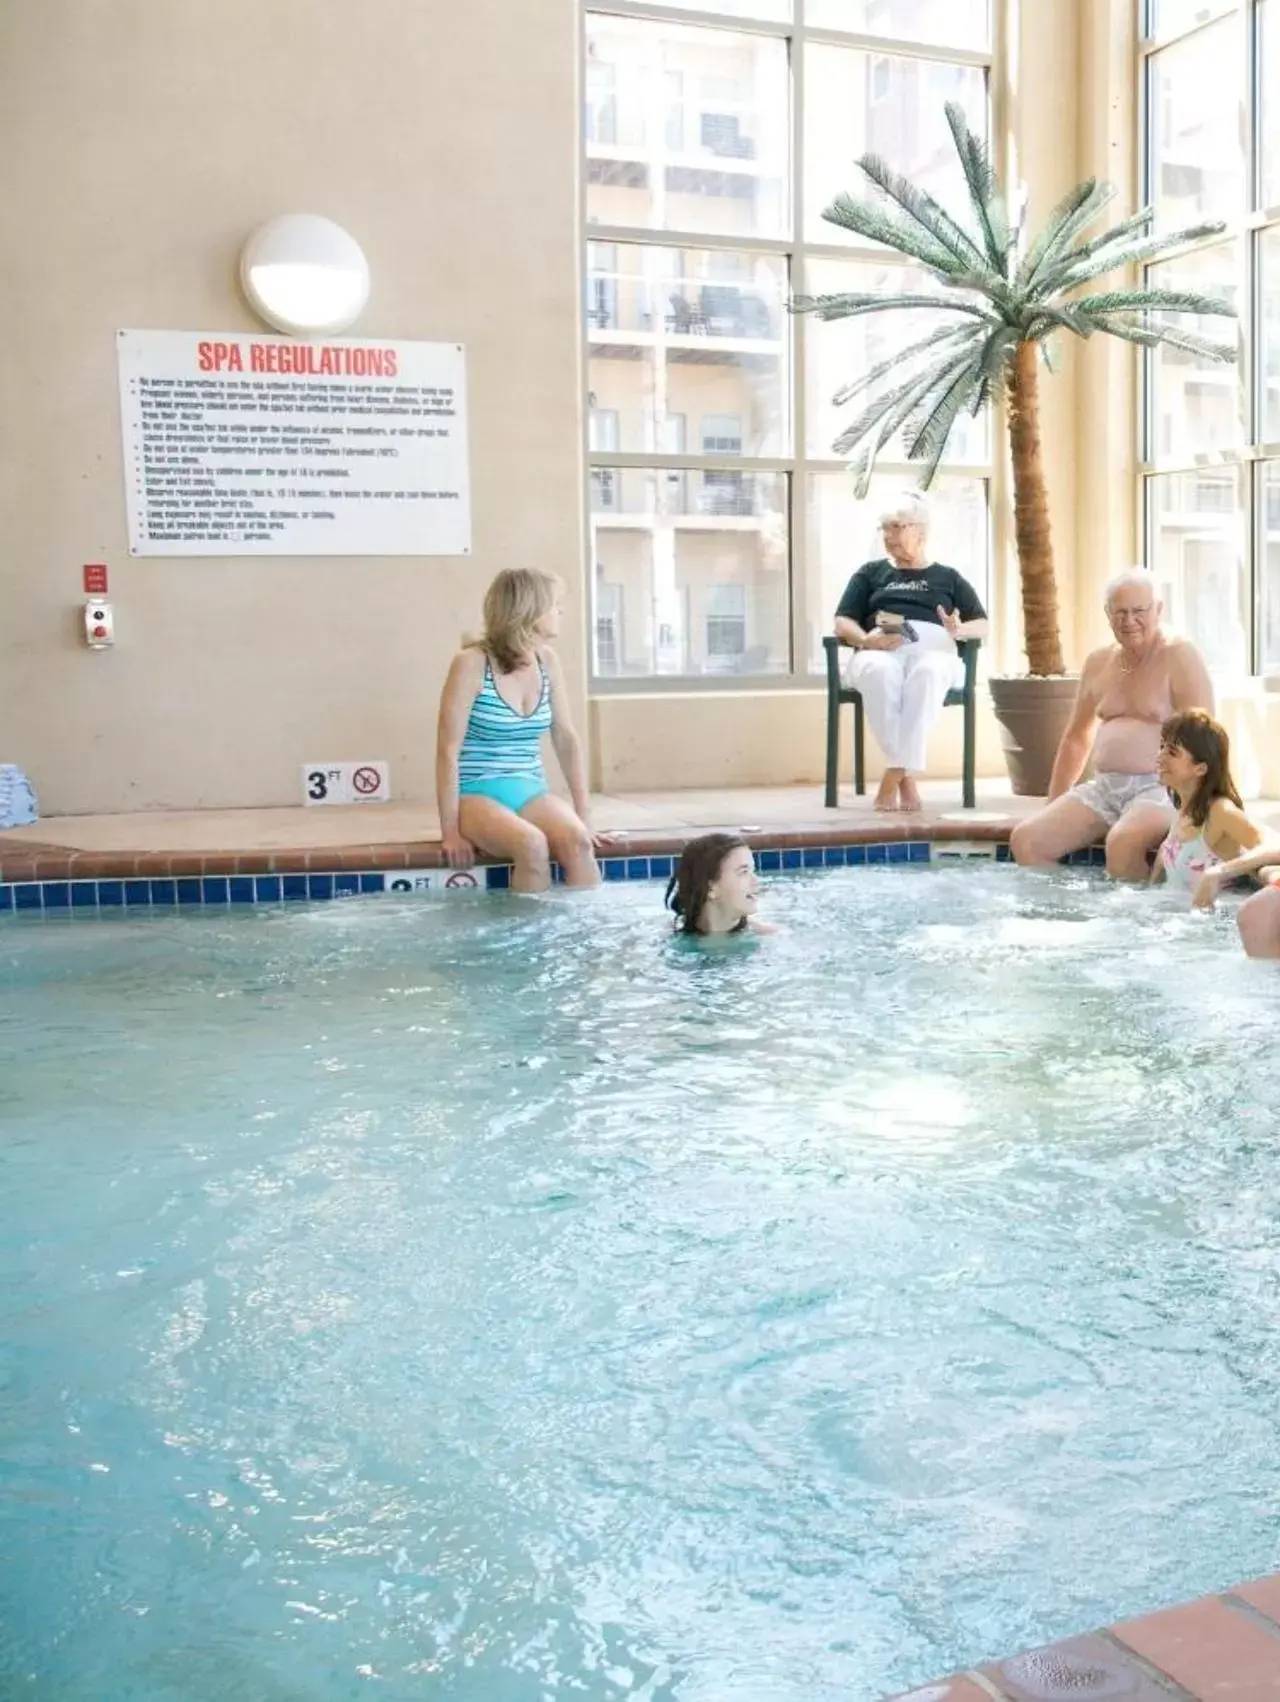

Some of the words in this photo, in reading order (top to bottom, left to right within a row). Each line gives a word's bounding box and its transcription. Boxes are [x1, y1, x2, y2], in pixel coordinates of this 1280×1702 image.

[198, 342, 242, 373] SPA
[250, 344, 397, 377] REGULATIONS
[308, 771, 327, 800] 3
[328, 770, 341, 781] FT
